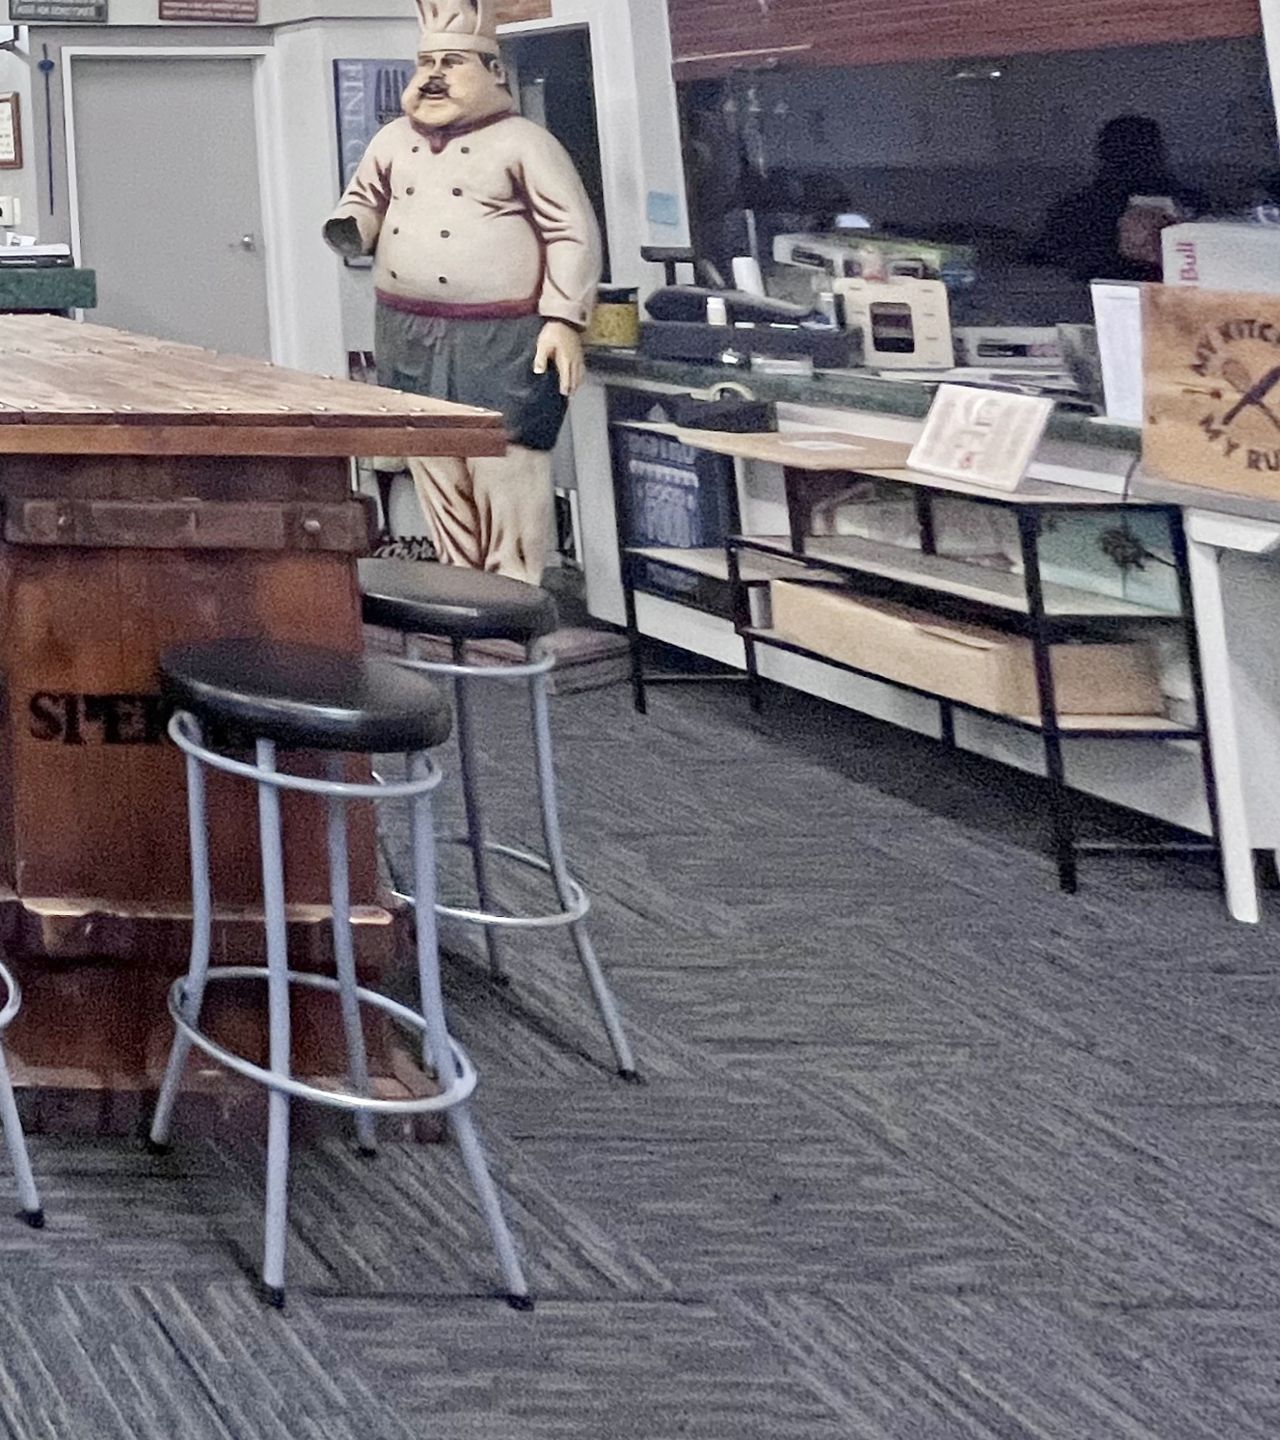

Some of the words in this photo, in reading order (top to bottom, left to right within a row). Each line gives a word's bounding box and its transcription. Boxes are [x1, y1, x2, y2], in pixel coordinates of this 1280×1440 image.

[1176, 241, 1199, 281] Bull
[1191, 333, 1218, 377] MY
[1218, 317, 1280, 344] KITC
[1198, 413, 1240, 456] MY
